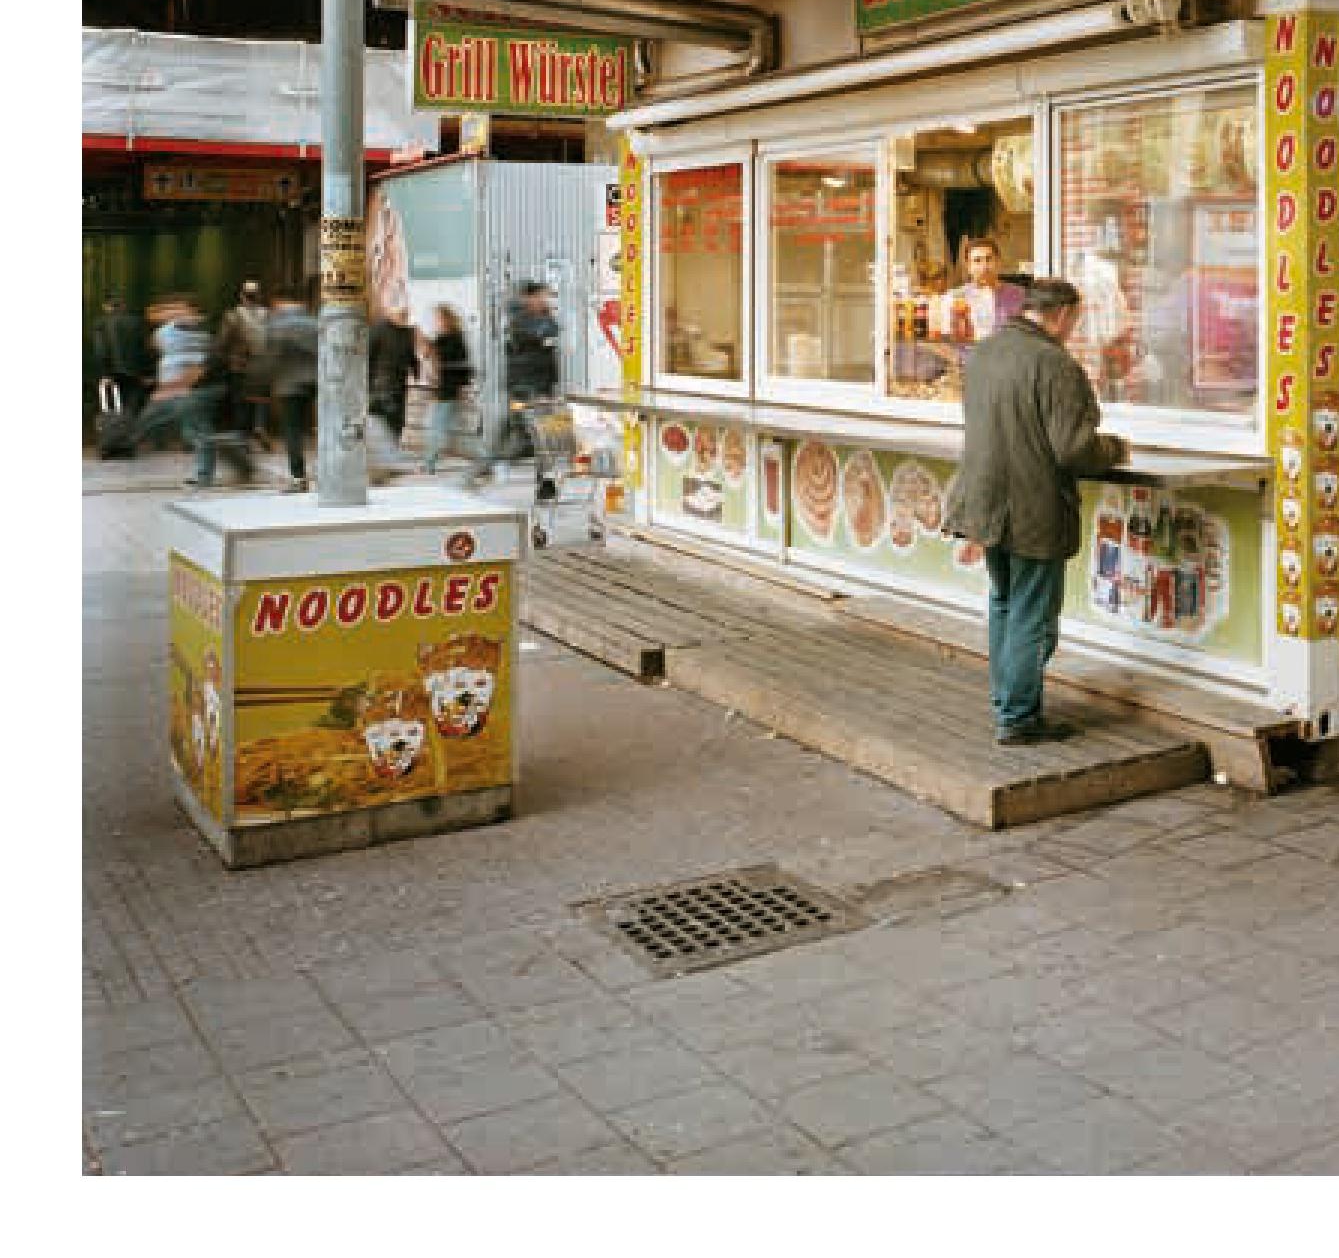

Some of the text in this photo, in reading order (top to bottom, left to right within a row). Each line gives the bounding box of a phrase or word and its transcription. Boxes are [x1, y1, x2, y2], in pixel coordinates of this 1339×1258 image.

[421, 33, 628, 113] Grill Würstel
[1274, 15, 1298, 415] NOODLES
[1312, 33, 1339, 381] NOODLES
[252, 572, 500, 635] NOODLES
